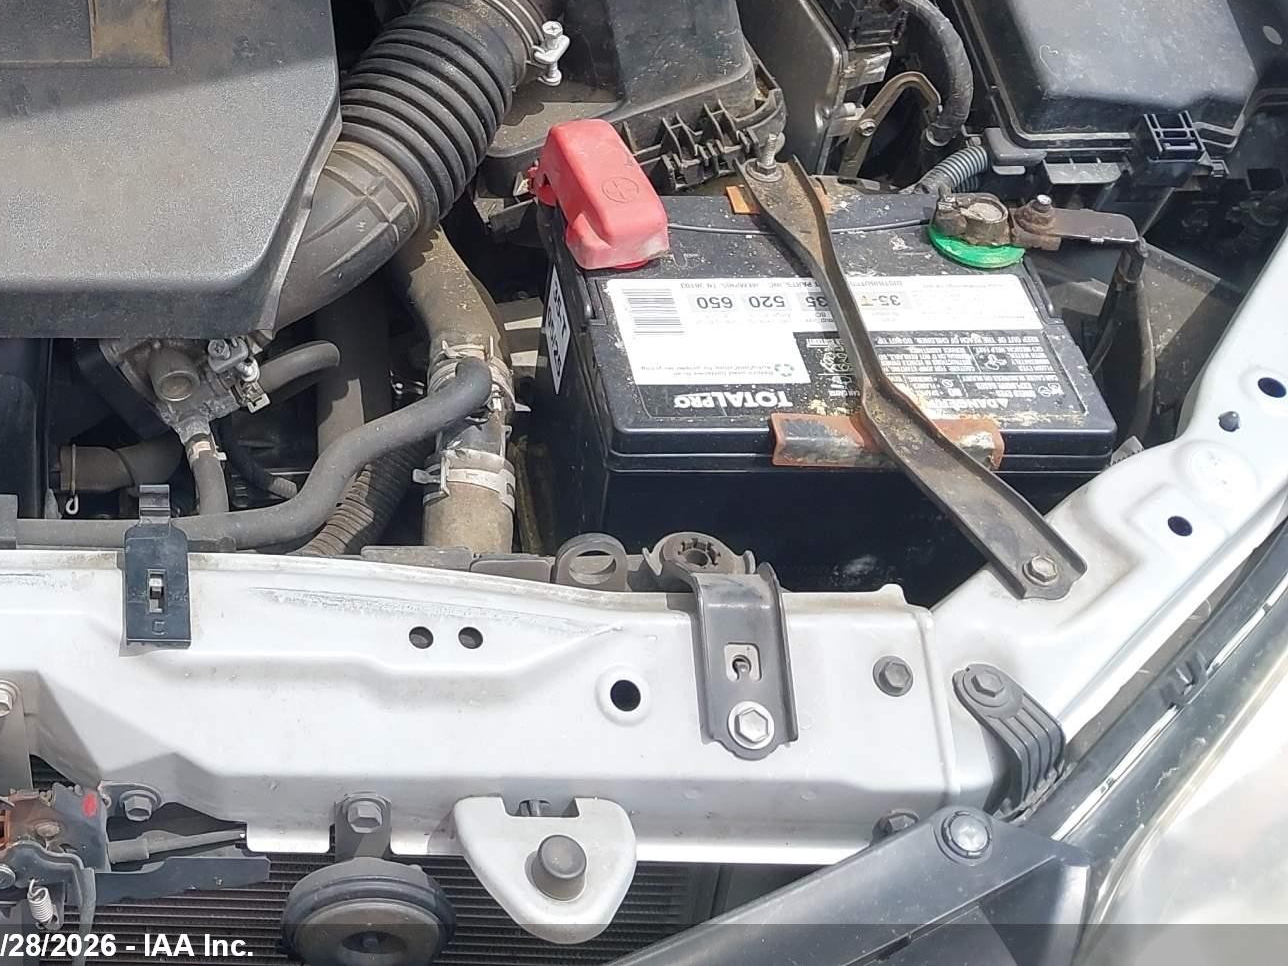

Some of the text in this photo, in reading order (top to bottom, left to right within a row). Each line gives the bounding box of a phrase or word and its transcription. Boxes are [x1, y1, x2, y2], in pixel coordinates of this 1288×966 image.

[695, 295, 733, 309] 650
[748, 295, 786, 308] 520
[804, 295, 828, 308] 35
